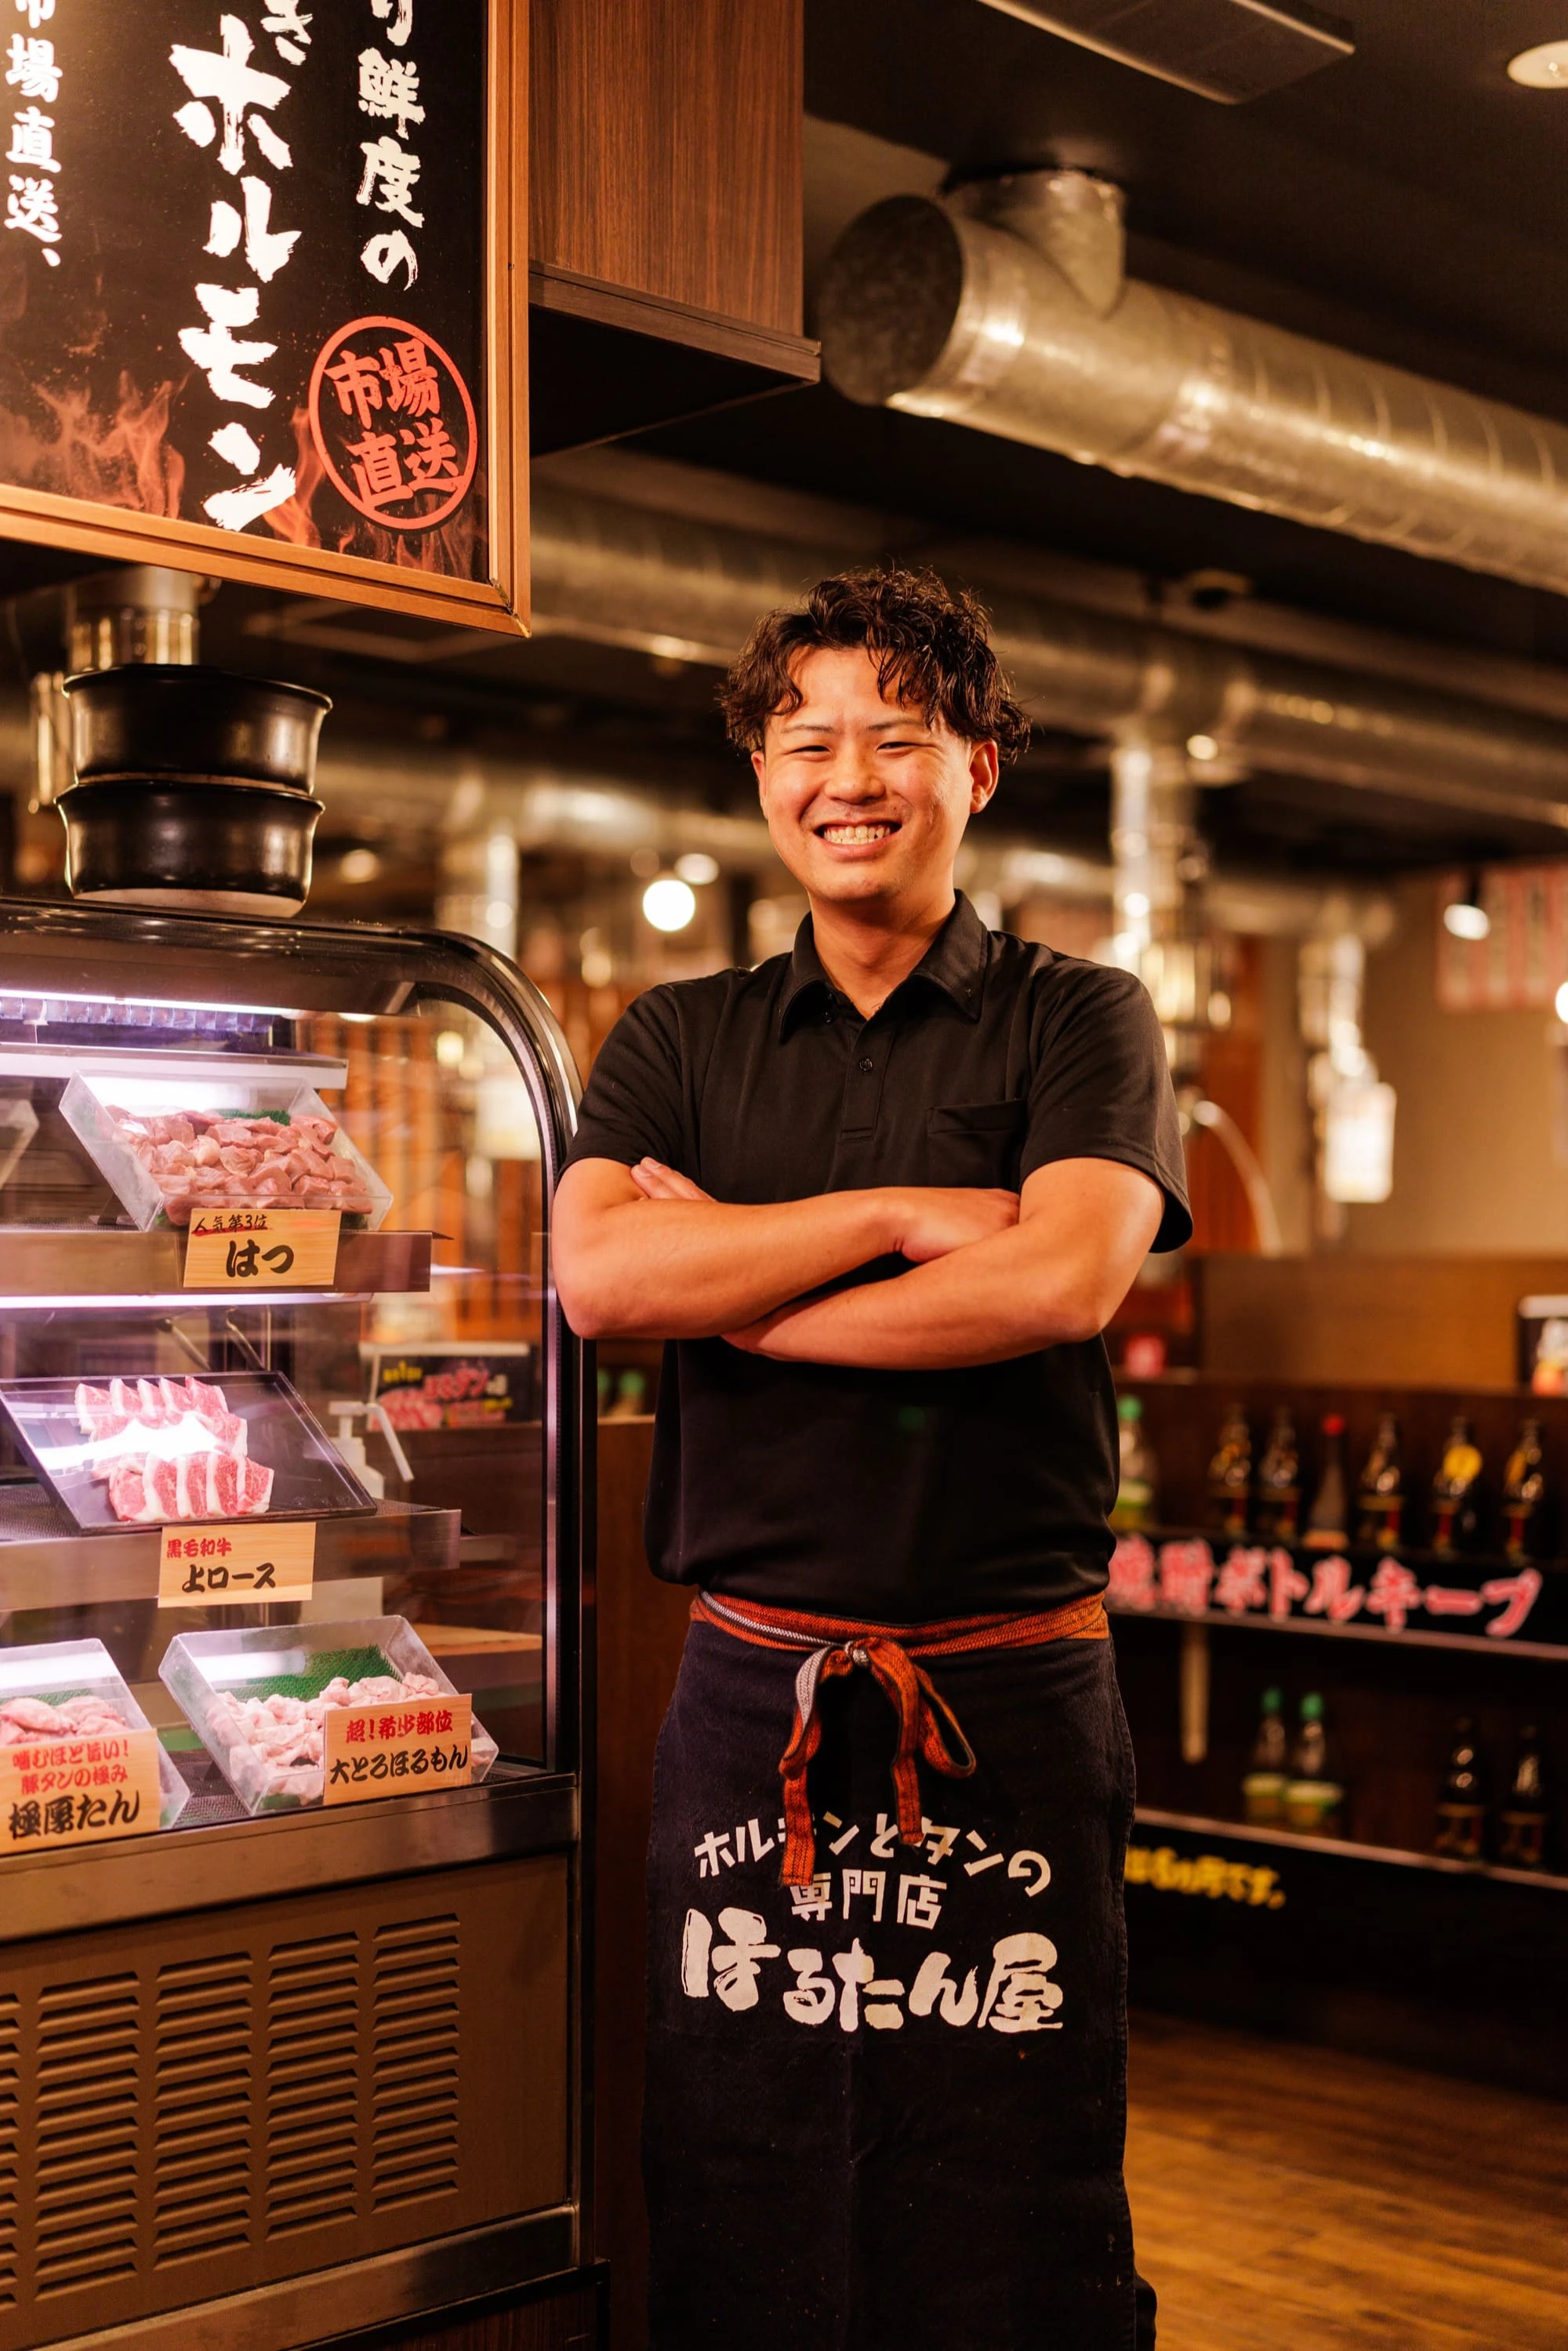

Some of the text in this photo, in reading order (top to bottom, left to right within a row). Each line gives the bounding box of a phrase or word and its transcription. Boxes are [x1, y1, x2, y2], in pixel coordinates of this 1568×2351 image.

[169, 14, 302, 532] ホルモン
[325, 337, 441, 430] 市場
[346, 419, 460, 508] 直送
[226, 1239, 294, 1277] はつ
[166, 1537, 232, 1558] 黒毛和牛
[181, 1563, 276, 1593] 上ロース
[330, 1744, 468, 1784] 大とろほるもん
[9, 1789, 140, 1840] 極厚たん
[694, 1812, 1051, 1898] ホルンとタンの
[789, 1864, 947, 1930] 専門店
[681, 1906, 1063, 2033] ほるたん屋
